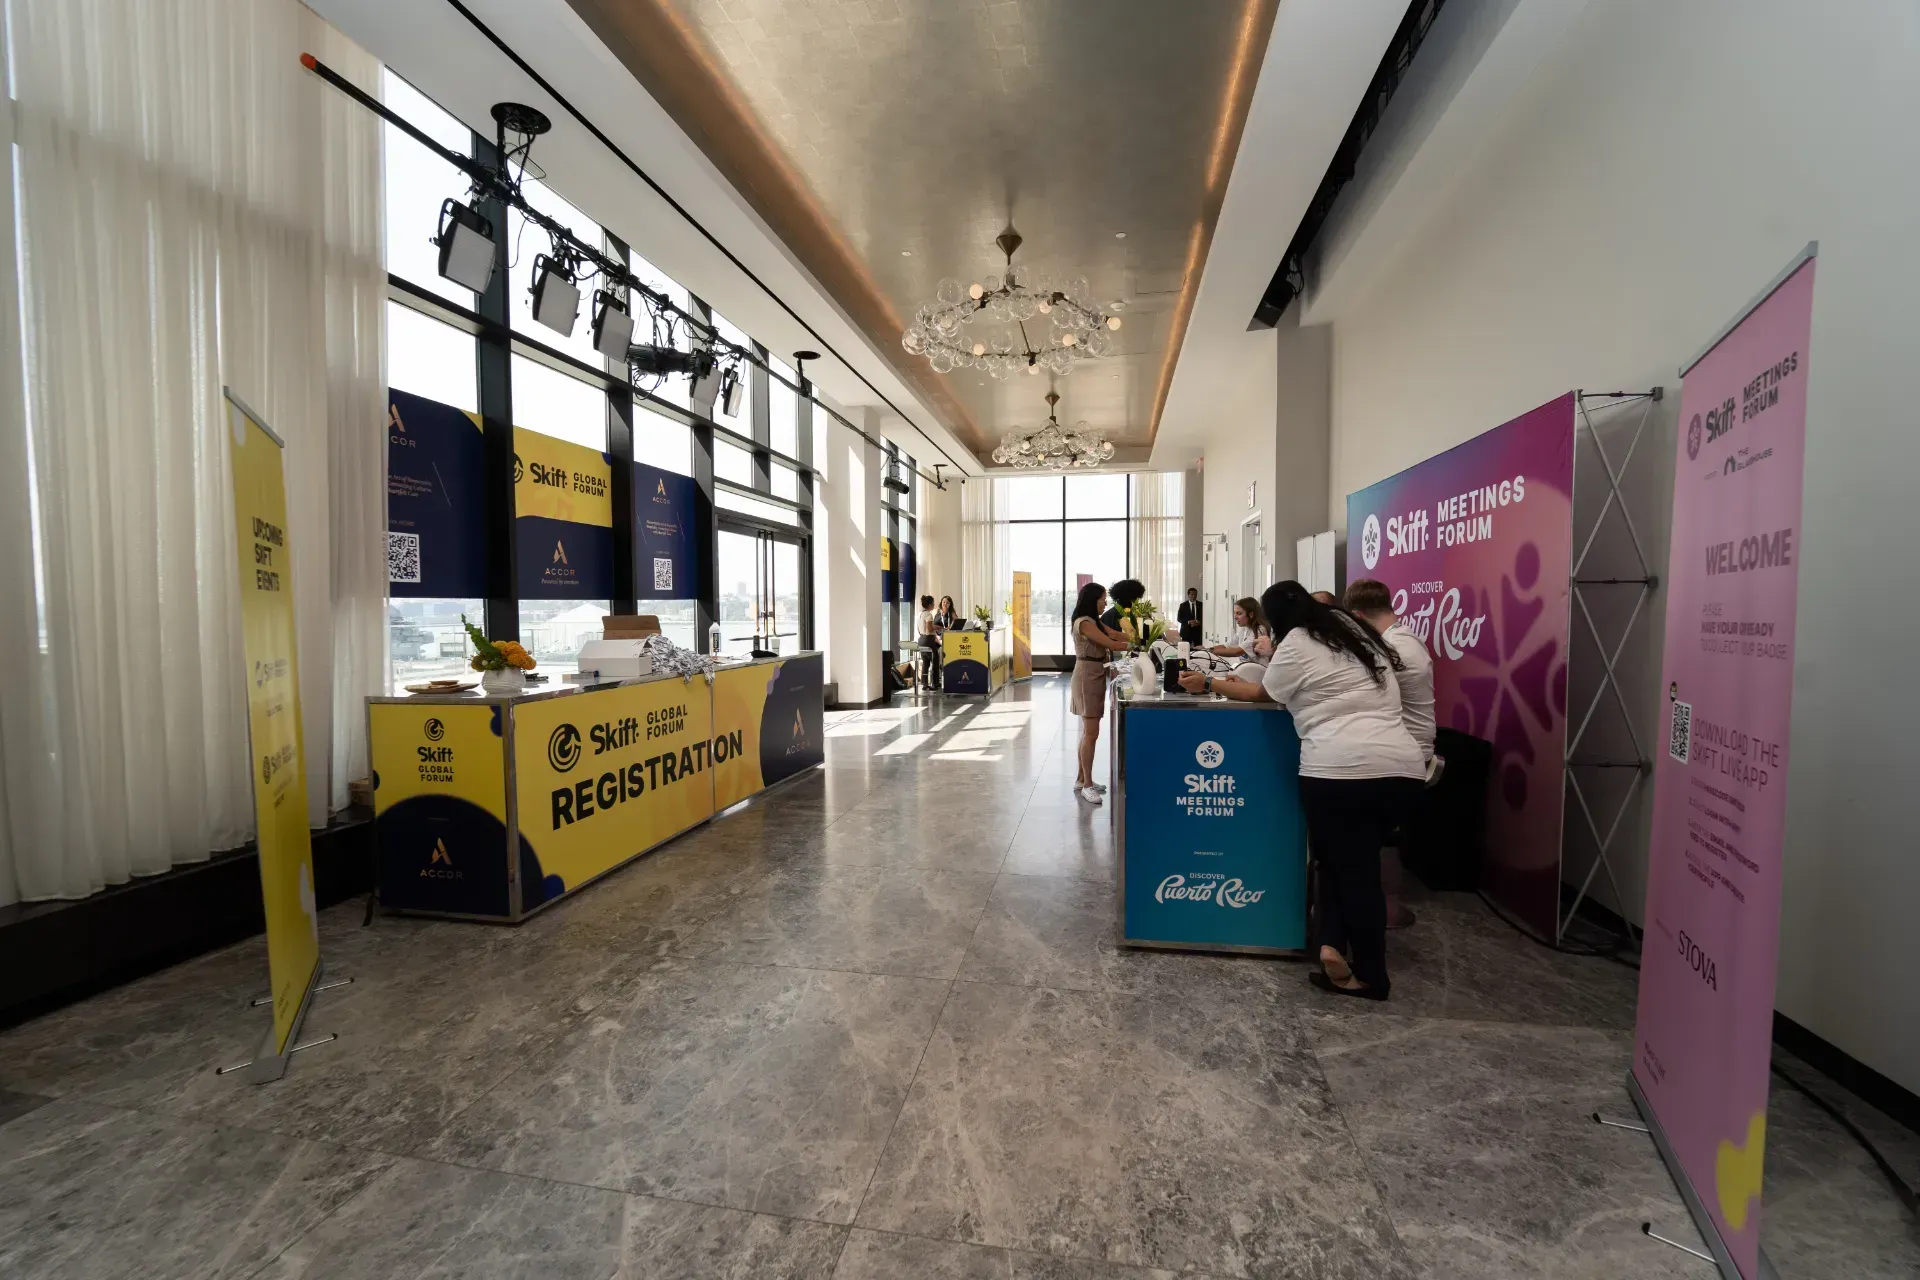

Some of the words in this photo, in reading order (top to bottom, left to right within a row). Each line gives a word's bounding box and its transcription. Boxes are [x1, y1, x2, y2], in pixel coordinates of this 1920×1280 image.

[1743, 351, 1798, 404] MEETINGS
[1742, 386, 1779, 423] FORUM
[390, 435, 417, 448] COR
[573, 472, 608, 488] GLOBAL
[573, 482, 604, 498] FORUM
[1437, 475, 1525, 523] MEETINGS
[1436, 514, 1492, 549] FORUM
[1705, 528, 1792, 576] WELCOME
[545, 567, 576, 576] ACCOR
[1411, 580, 1444, 593] DISCOVER
[1433, 587, 1486, 660] Rico
[646, 703, 689, 724] GLOBAL
[646, 718, 684, 740] FORUM
[1752, 737, 1780, 768] THE
[418, 765, 455, 774] GLOBAL
[420, 774, 453, 783] FORUM
[551, 729, 744, 831] REGISTRATION
[1176, 796, 1245, 807] MEETINGS
[1187, 807, 1234, 817] FORUM
[420, 869, 465, 880] ACCOR
[1189, 872, 1226, 880] DISCOVER
[1155, 874, 1217, 904] Puerto
[1215, 878, 1266, 908] Rico
[1678, 930, 1718, 992] STOVA
